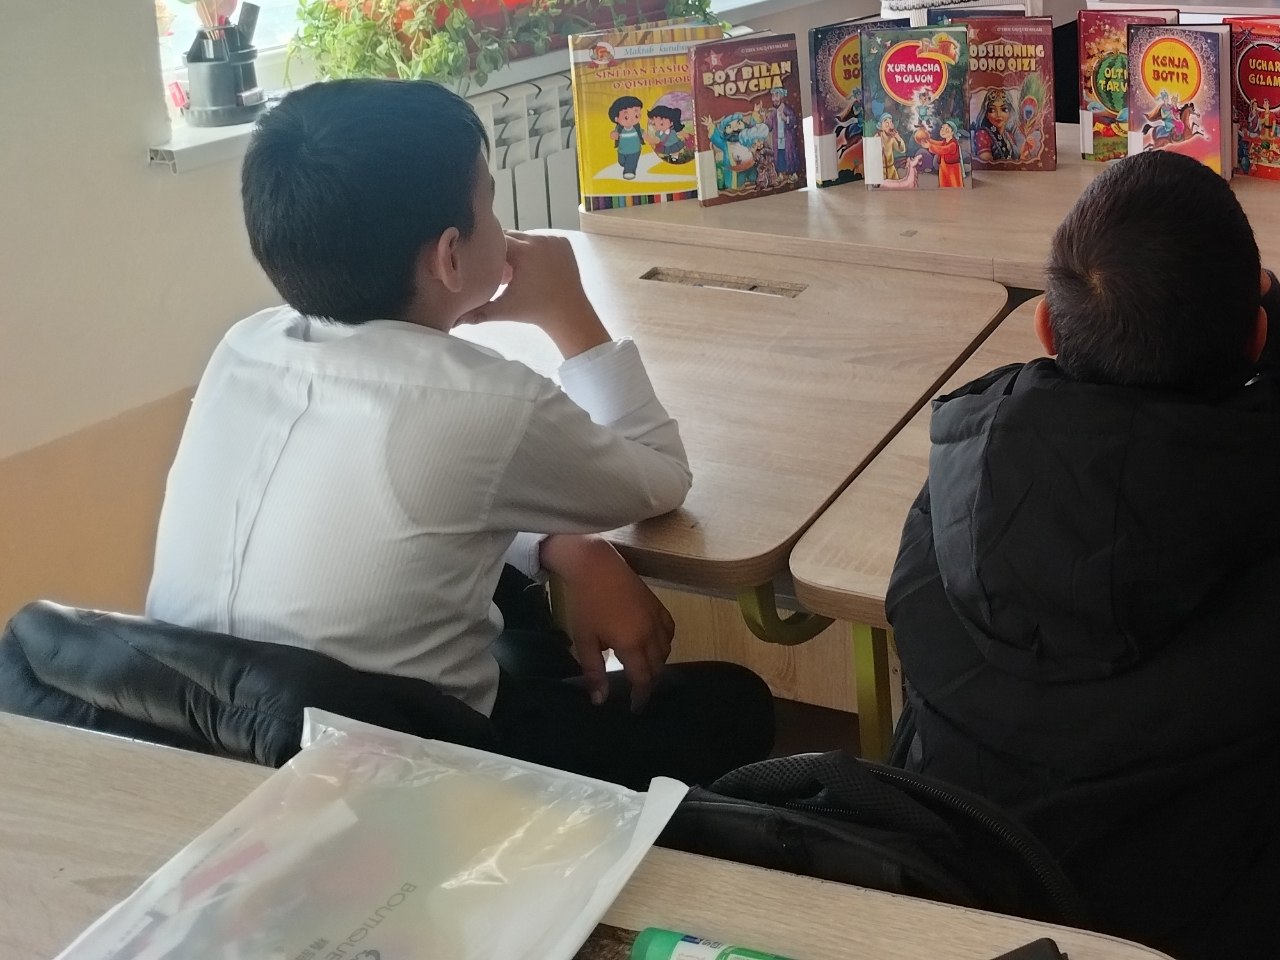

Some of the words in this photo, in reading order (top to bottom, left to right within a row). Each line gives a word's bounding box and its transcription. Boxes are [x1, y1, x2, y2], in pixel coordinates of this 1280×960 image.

[886, 63, 941, 73] XURMACHA
[969, 58, 1006, 71] DONO
[1007, 58, 1036, 72] QIZI
[1151, 55, 1190, 69] KENJA
[702, 67, 738, 85] BOY
[741, 60, 792, 80] BILAN
[895, 74, 933, 83] POLVON
[1152, 69, 1189, 83] BOTIR
[713, 75, 783, 97] NOVCHA
